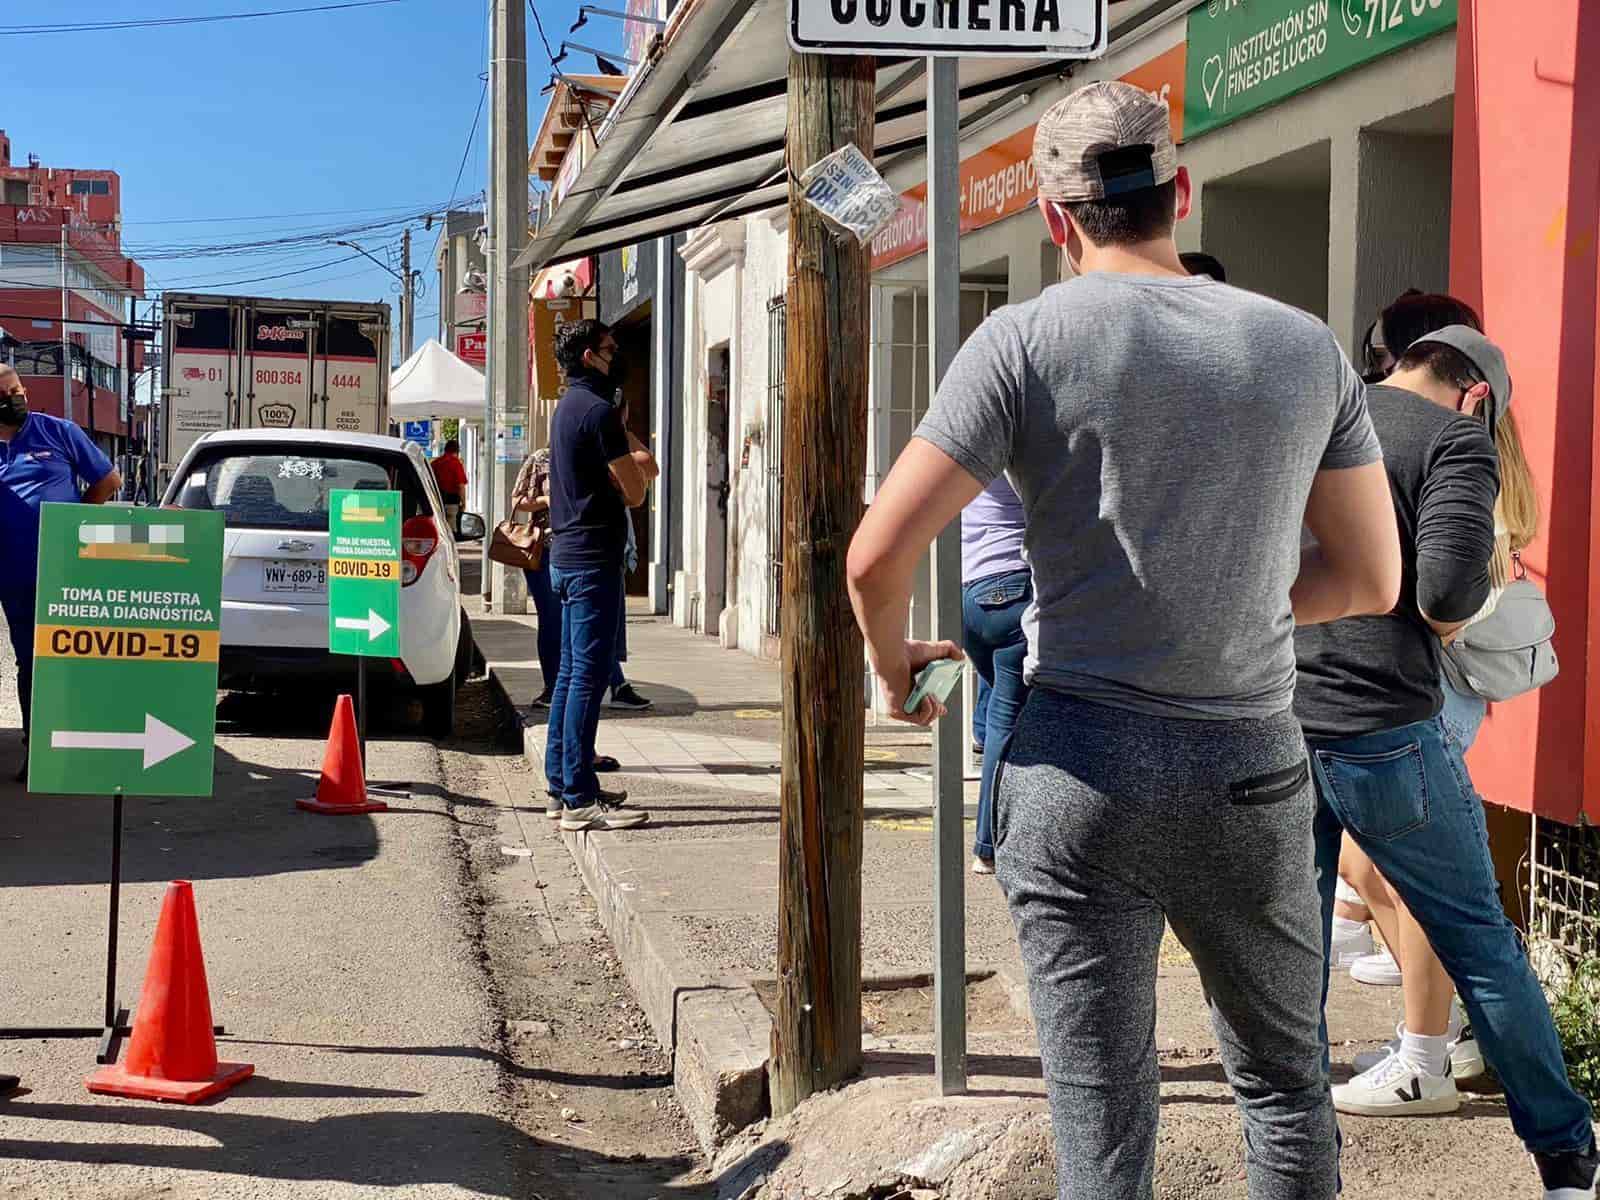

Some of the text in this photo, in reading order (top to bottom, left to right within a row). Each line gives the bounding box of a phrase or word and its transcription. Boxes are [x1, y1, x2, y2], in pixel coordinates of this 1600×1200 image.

[1229, 0, 1329, 71] INSTITUCIÓN SIN
[1227, 28, 1327, 97] FINES DE LUCRO
[871, 213, 913, 257] oratorio
[968, 155, 1036, 217] Imageno
[208, 368, 223, 382] 01
[332, 373, 361, 390] 4444
[264, 409, 290, 420] 100%
[334, 560, 391, 578] COVID-19
[61, 587, 201, 606] TOMA DE MUESTRA
[48, 603, 214, 623] PRUEBA DIAGNÓSTICA
[51, 629, 201, 659] COVID-19
